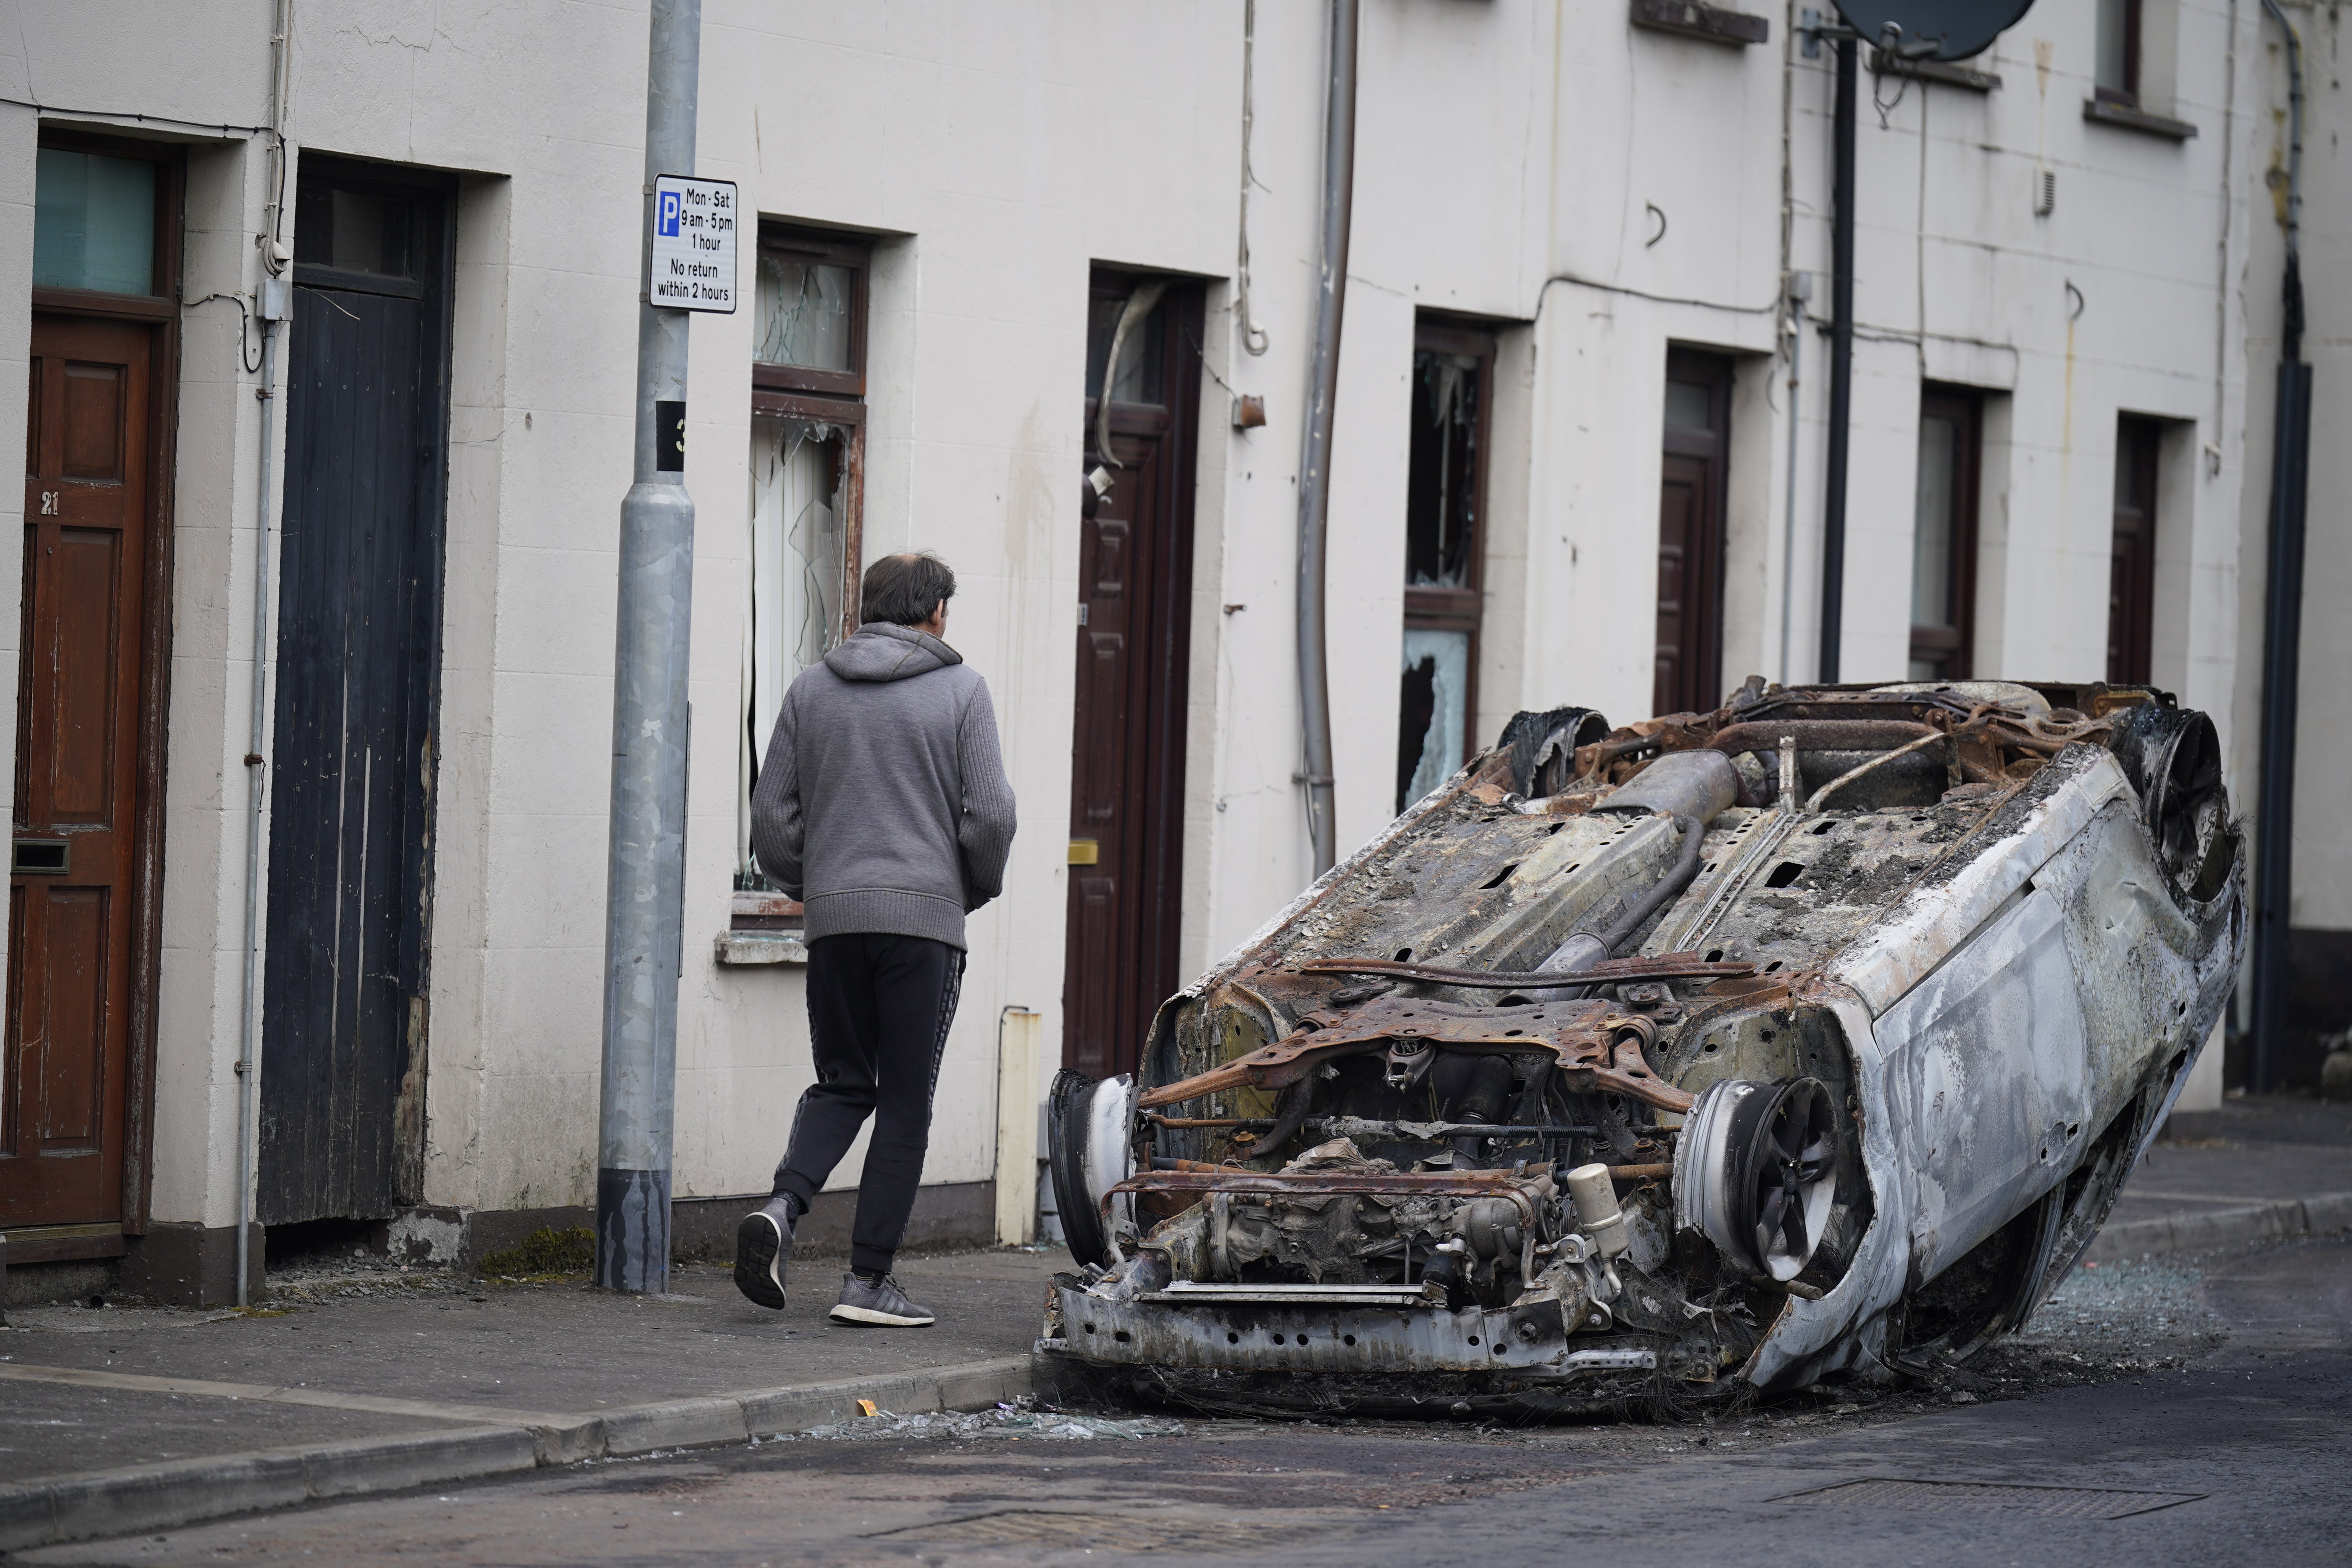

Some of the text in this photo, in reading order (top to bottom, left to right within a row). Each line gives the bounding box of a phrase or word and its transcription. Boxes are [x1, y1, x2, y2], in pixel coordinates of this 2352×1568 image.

[687, 188, 706, 205] Mon
[714, 191, 729, 208] Sat
[663, 195, 678, 233] P
[692, 233, 720, 250] 1 hour
[671, 258, 717, 278] No return
[658, 280, 728, 301] within 2 hours
[40, 491, 58, 515] 21
